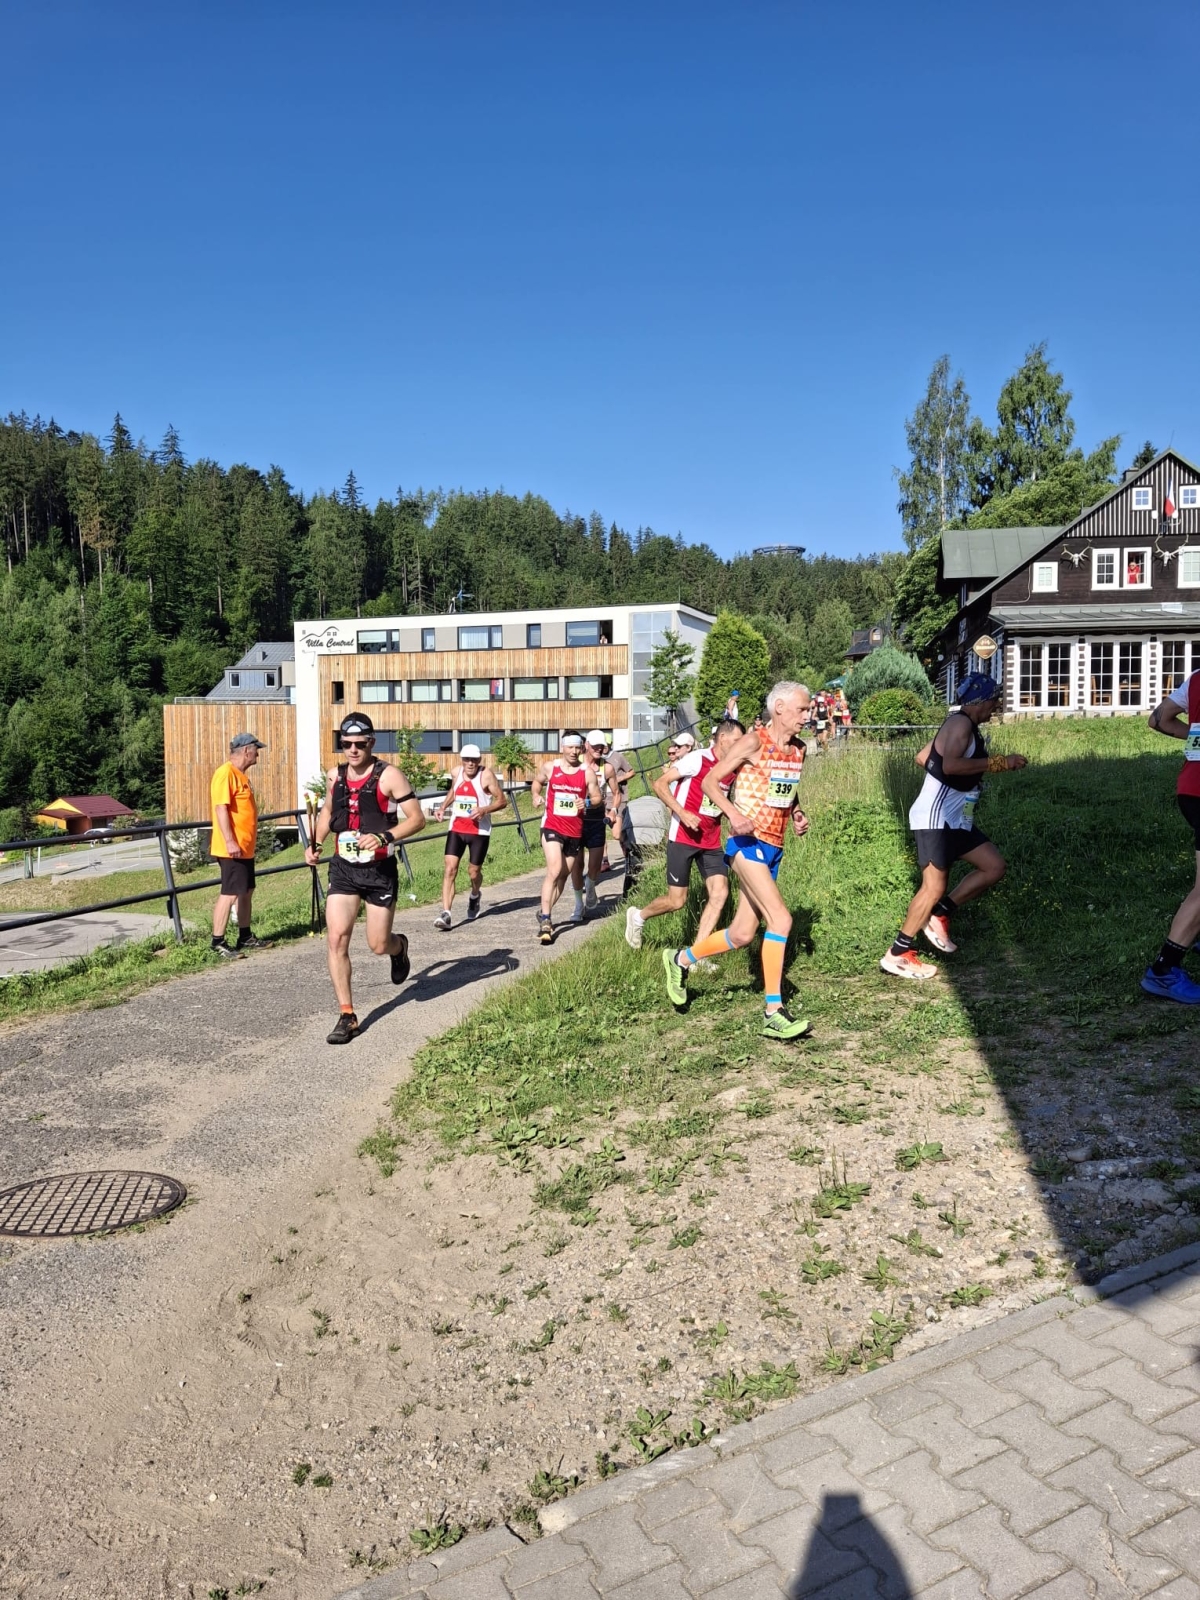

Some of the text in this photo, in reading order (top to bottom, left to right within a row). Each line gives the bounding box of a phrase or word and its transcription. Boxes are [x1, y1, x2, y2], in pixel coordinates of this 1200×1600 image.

[305, 638, 354, 648] Villa Central
[767, 759, 802, 769] Nederlan
[775, 782, 793, 795] 339
[559, 800, 574, 808] 340
[346, 842, 359, 852] 55
